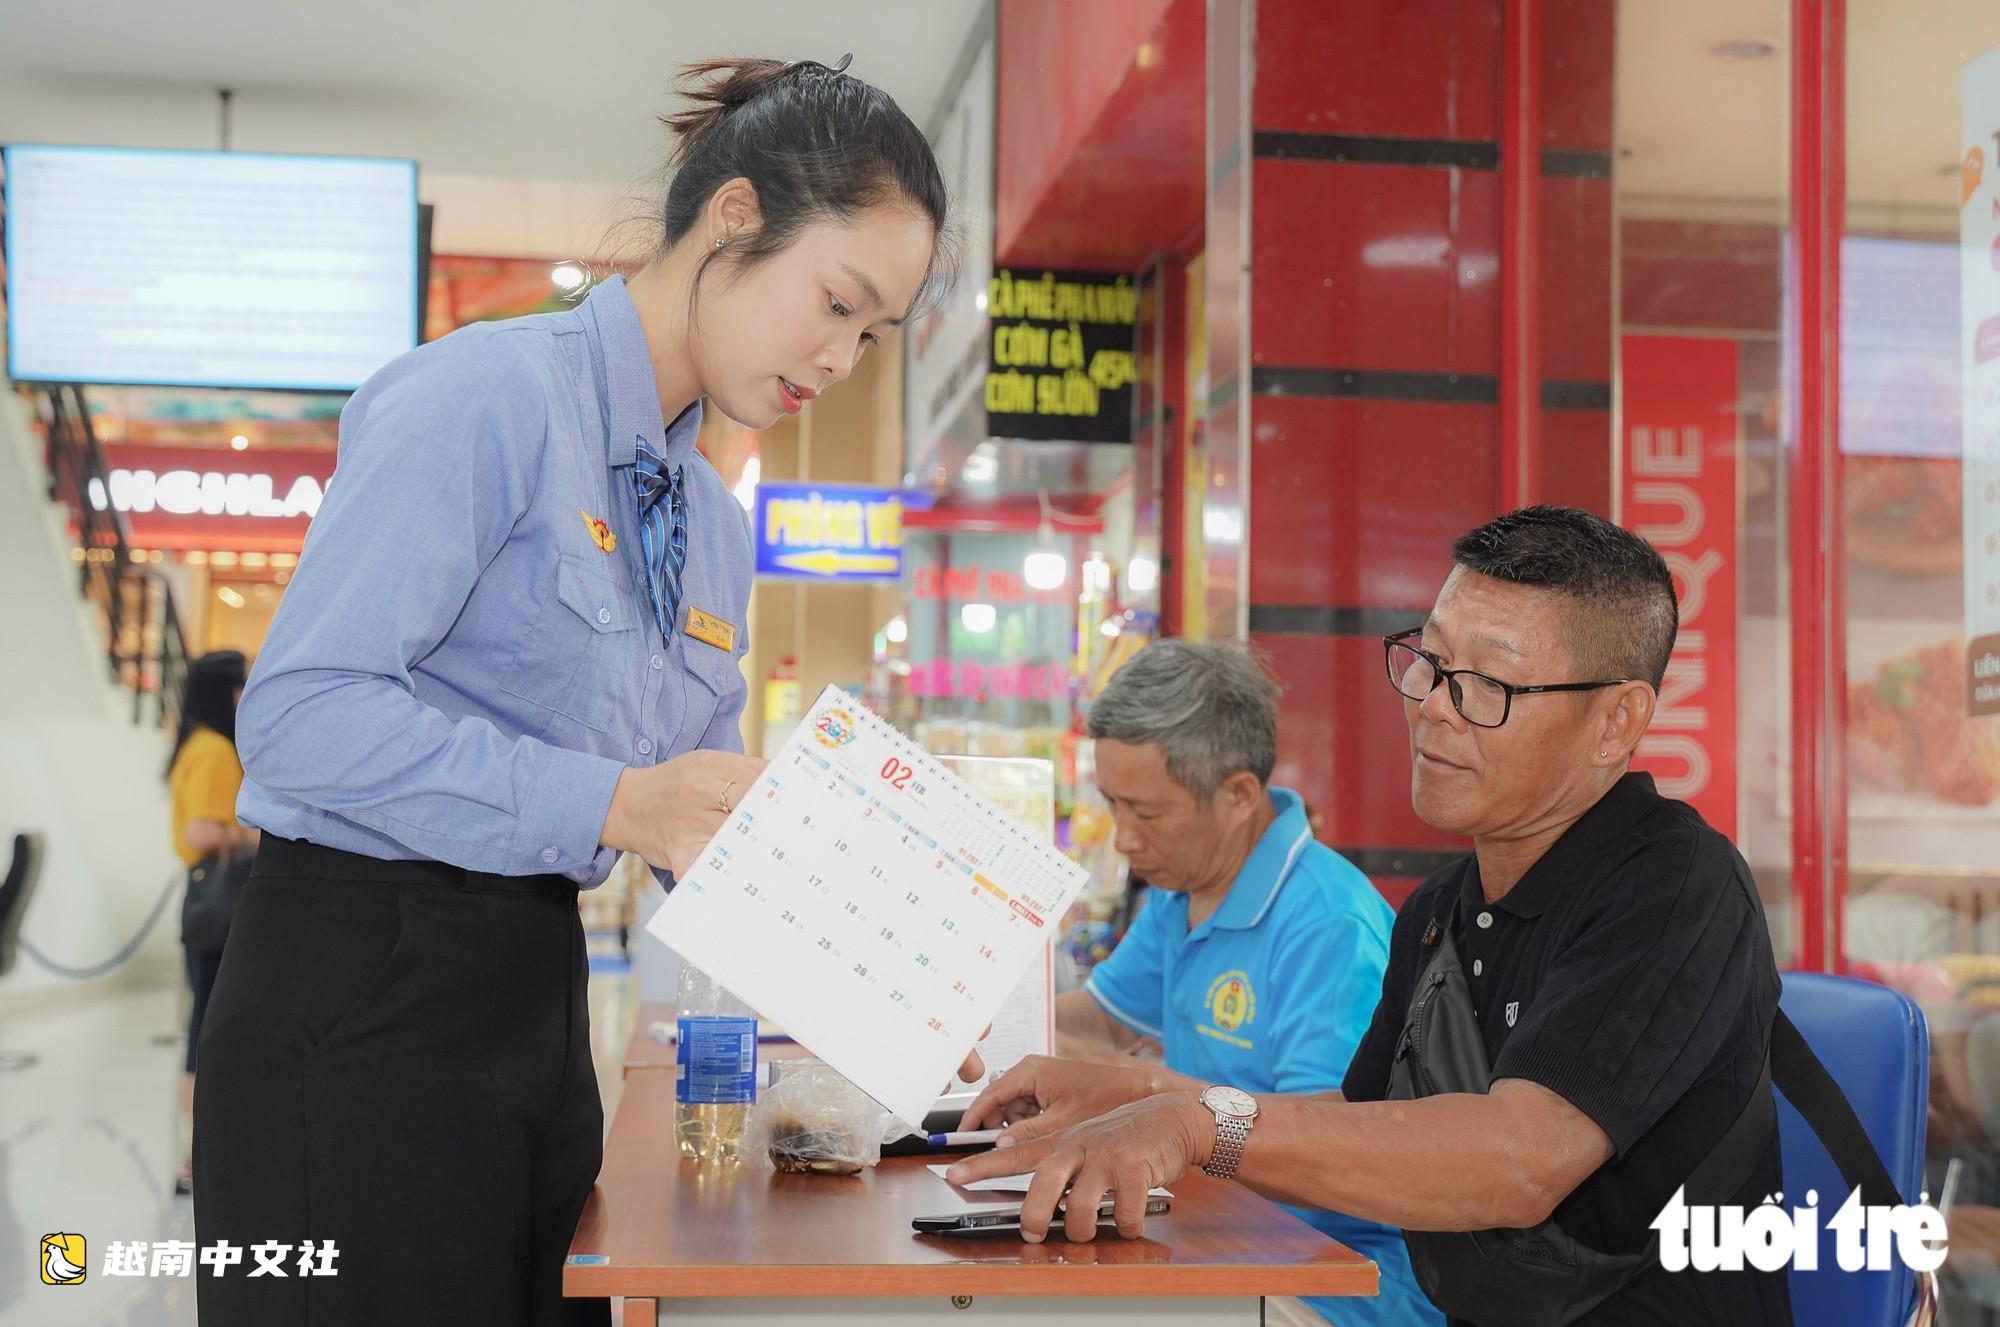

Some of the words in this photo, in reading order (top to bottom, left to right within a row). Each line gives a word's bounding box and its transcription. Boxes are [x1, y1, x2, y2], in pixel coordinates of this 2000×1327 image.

[794, 756, 801, 765] 1
[828, 781, 836, 790] 2
[864, 807, 873, 817] 3
[901, 835, 909, 844] 4
[936, 860, 945, 870] 5
[971, 886, 979, 895] 6
[1008, 914, 1017, 922] 7
[881, 757, 912, 791] 02
[709, 857, 723, 871] 22
[744, 883, 758, 896] 23
[781, 910, 795, 923] 24
[818, 937, 831, 950] 25
[854, 964, 867, 976] 26
[889, 990, 904, 1002] 27
[928, 1018, 942, 1031] 28
[737, 822, 750, 834] 15
[772, 848, 784, 860] 16
[809, 875, 822, 886] 17
[845, 901, 858, 914] 18
[881, 928, 893, 940] 19
[915, 953, 929, 966] 20
[953, 981, 966, 994] 21
[803, 816, 810, 824] 9
[835, 840, 847, 852] 10
[870, 866, 883, 878] 11
[906, 892, 919, 904] 12
[942, 918, 954, 930] 13
[979, 946, 992, 958] 14
